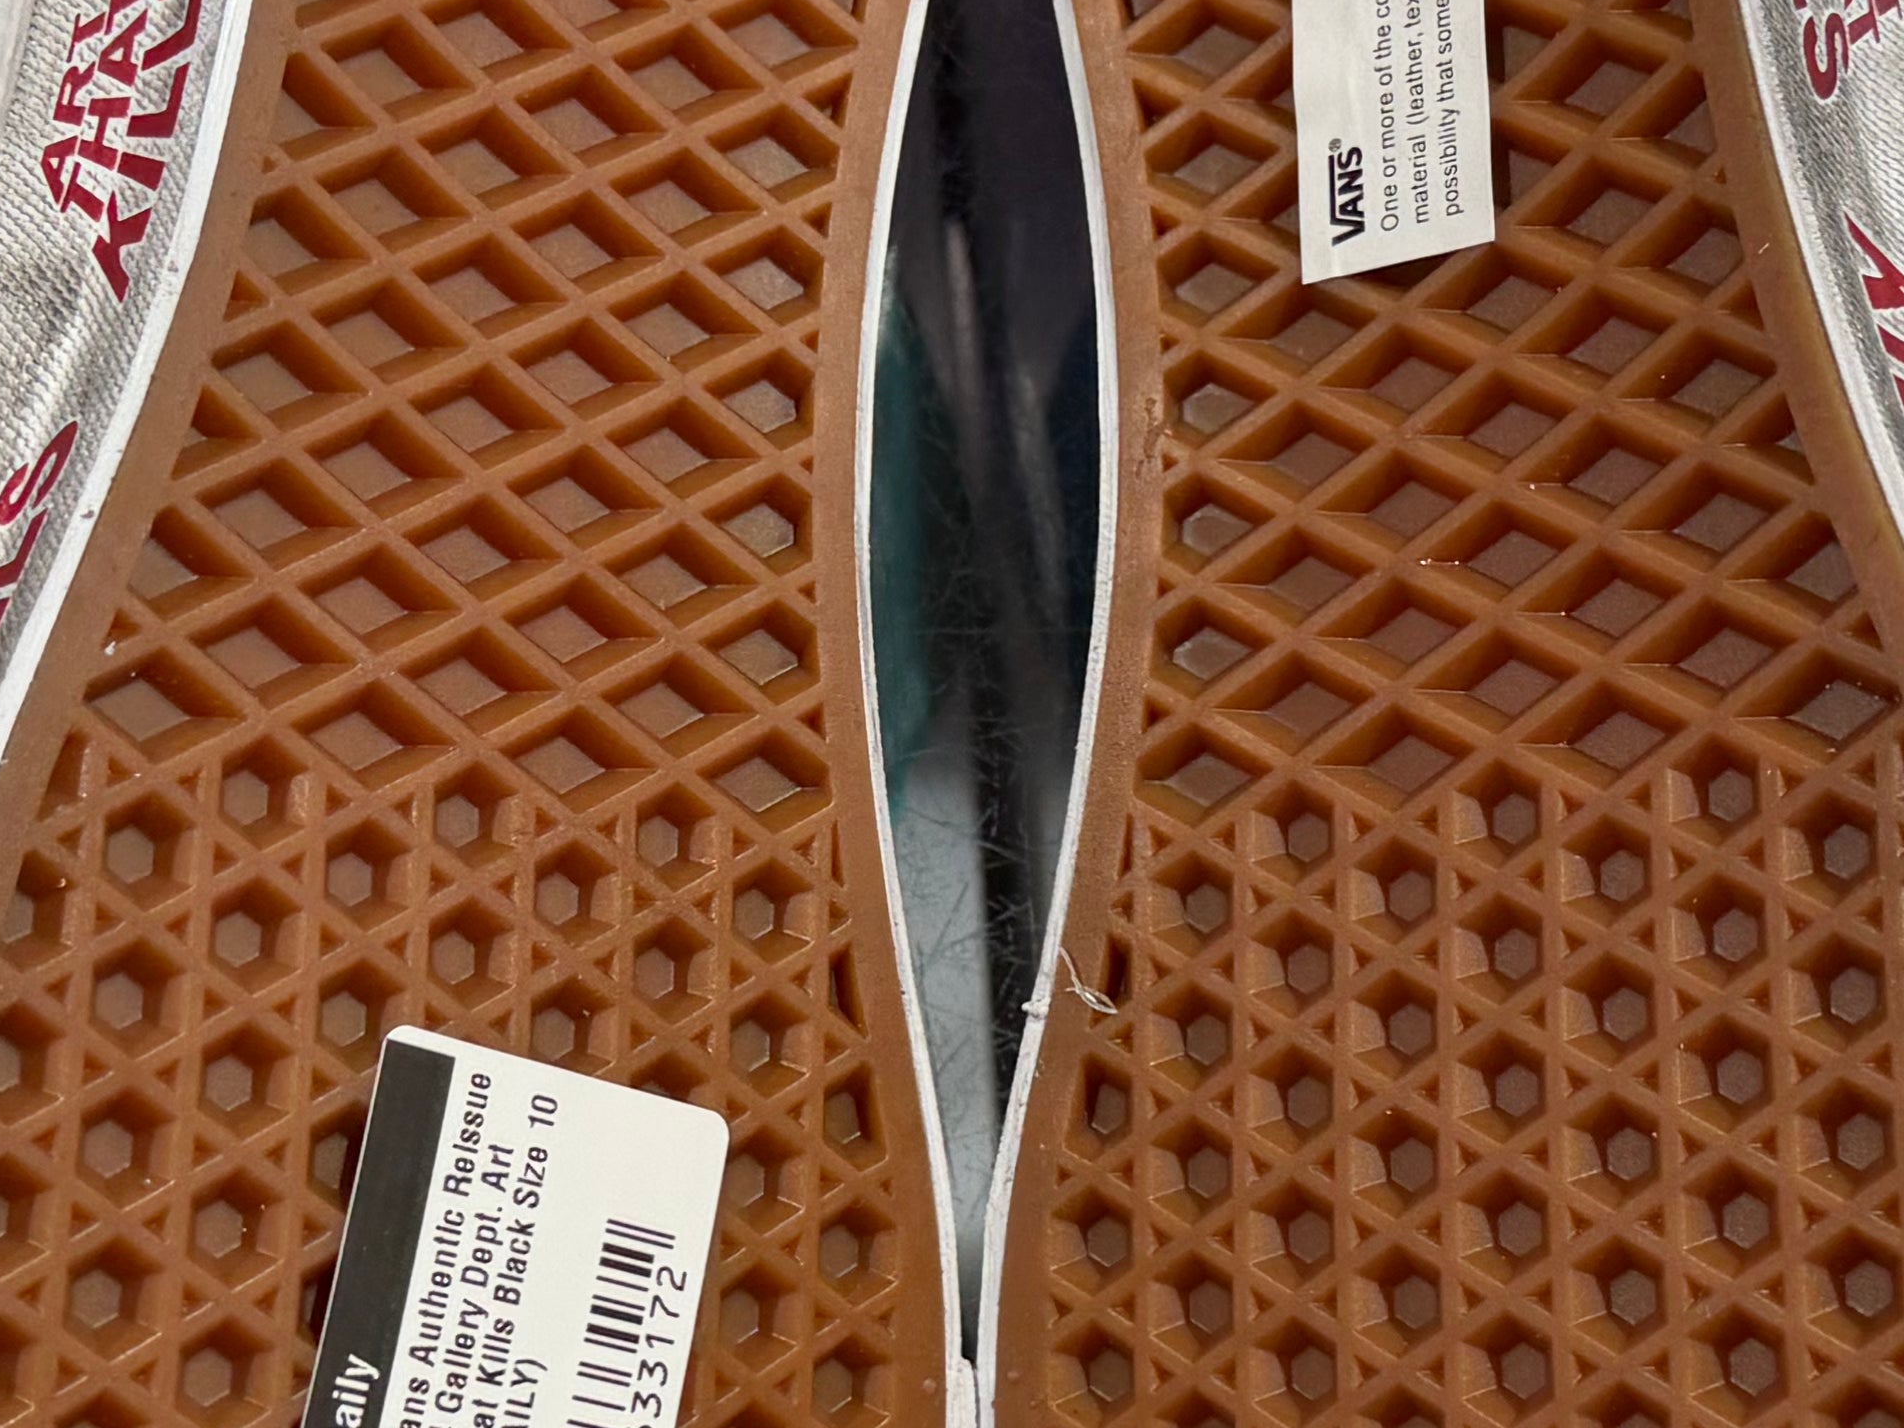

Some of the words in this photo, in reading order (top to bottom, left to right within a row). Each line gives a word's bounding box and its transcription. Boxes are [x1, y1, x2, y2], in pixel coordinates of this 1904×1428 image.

[1373, 25, 1391, 61] the
[1374, 66, 1393, 85] of
[39, 12, 107, 206] ART
[1405, 32, 1430, 126] (leather,
[1436, 56, 1456, 102] that
[1381, 92, 1395, 149] more
[1382, 154, 1397, 177] or
[1409, 134, 1430, 224] material
[1436, 107, 1464, 217] possibility
[1381, 184, 1399, 232] One
[527, 1093, 559, 1129] 10
[480, 1144, 514, 1192] Art
[512, 1146, 549, 1209] Size
[409, 1208, 466, 1367] Authentic
[443, 1072, 492, 1197] Reissue
[460, 1206, 504, 1289] Dept.
[493, 1220, 536, 1306] Black
[434, 1298, 490, 1413] Gallery
[475, 1317, 515, 1387] Kills
